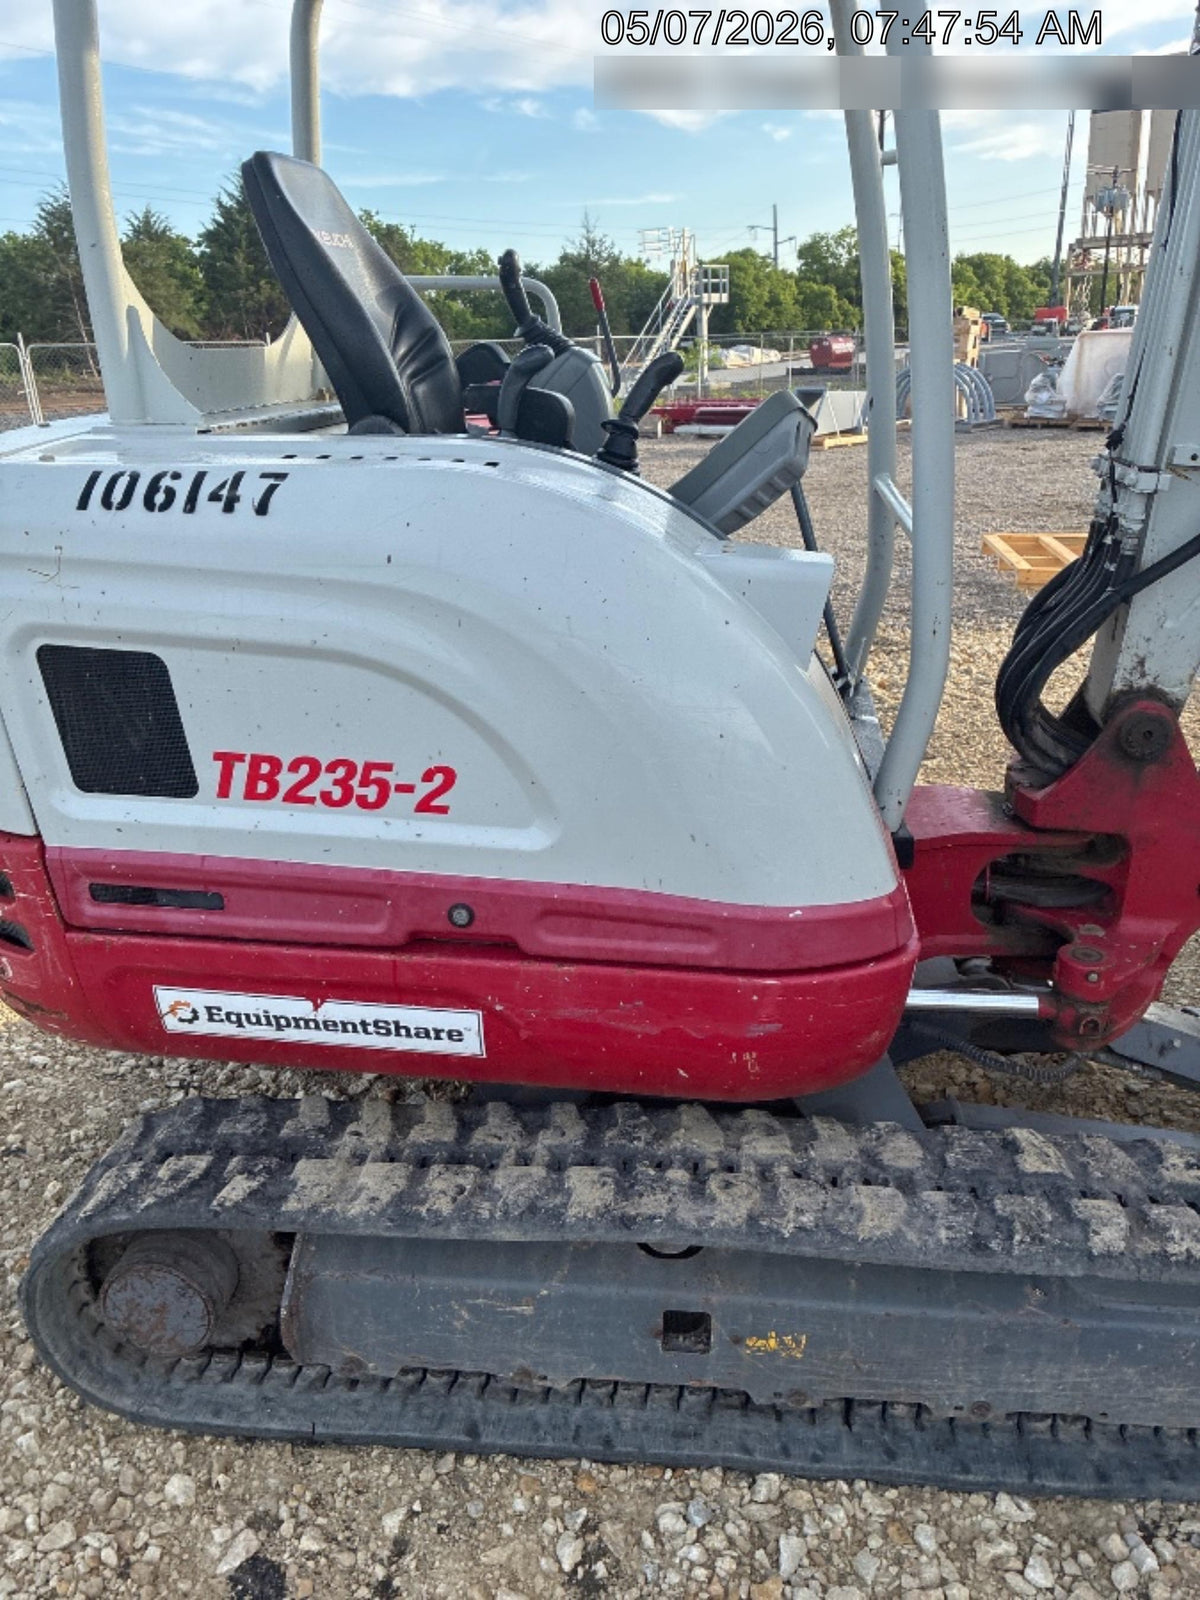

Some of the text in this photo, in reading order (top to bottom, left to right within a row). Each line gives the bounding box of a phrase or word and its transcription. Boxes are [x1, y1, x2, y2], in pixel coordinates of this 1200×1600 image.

[76, 471, 290, 516] 106147
[212, 751, 457, 814] TB235-2
[203, 1005, 465, 1042] EquipmentShare
